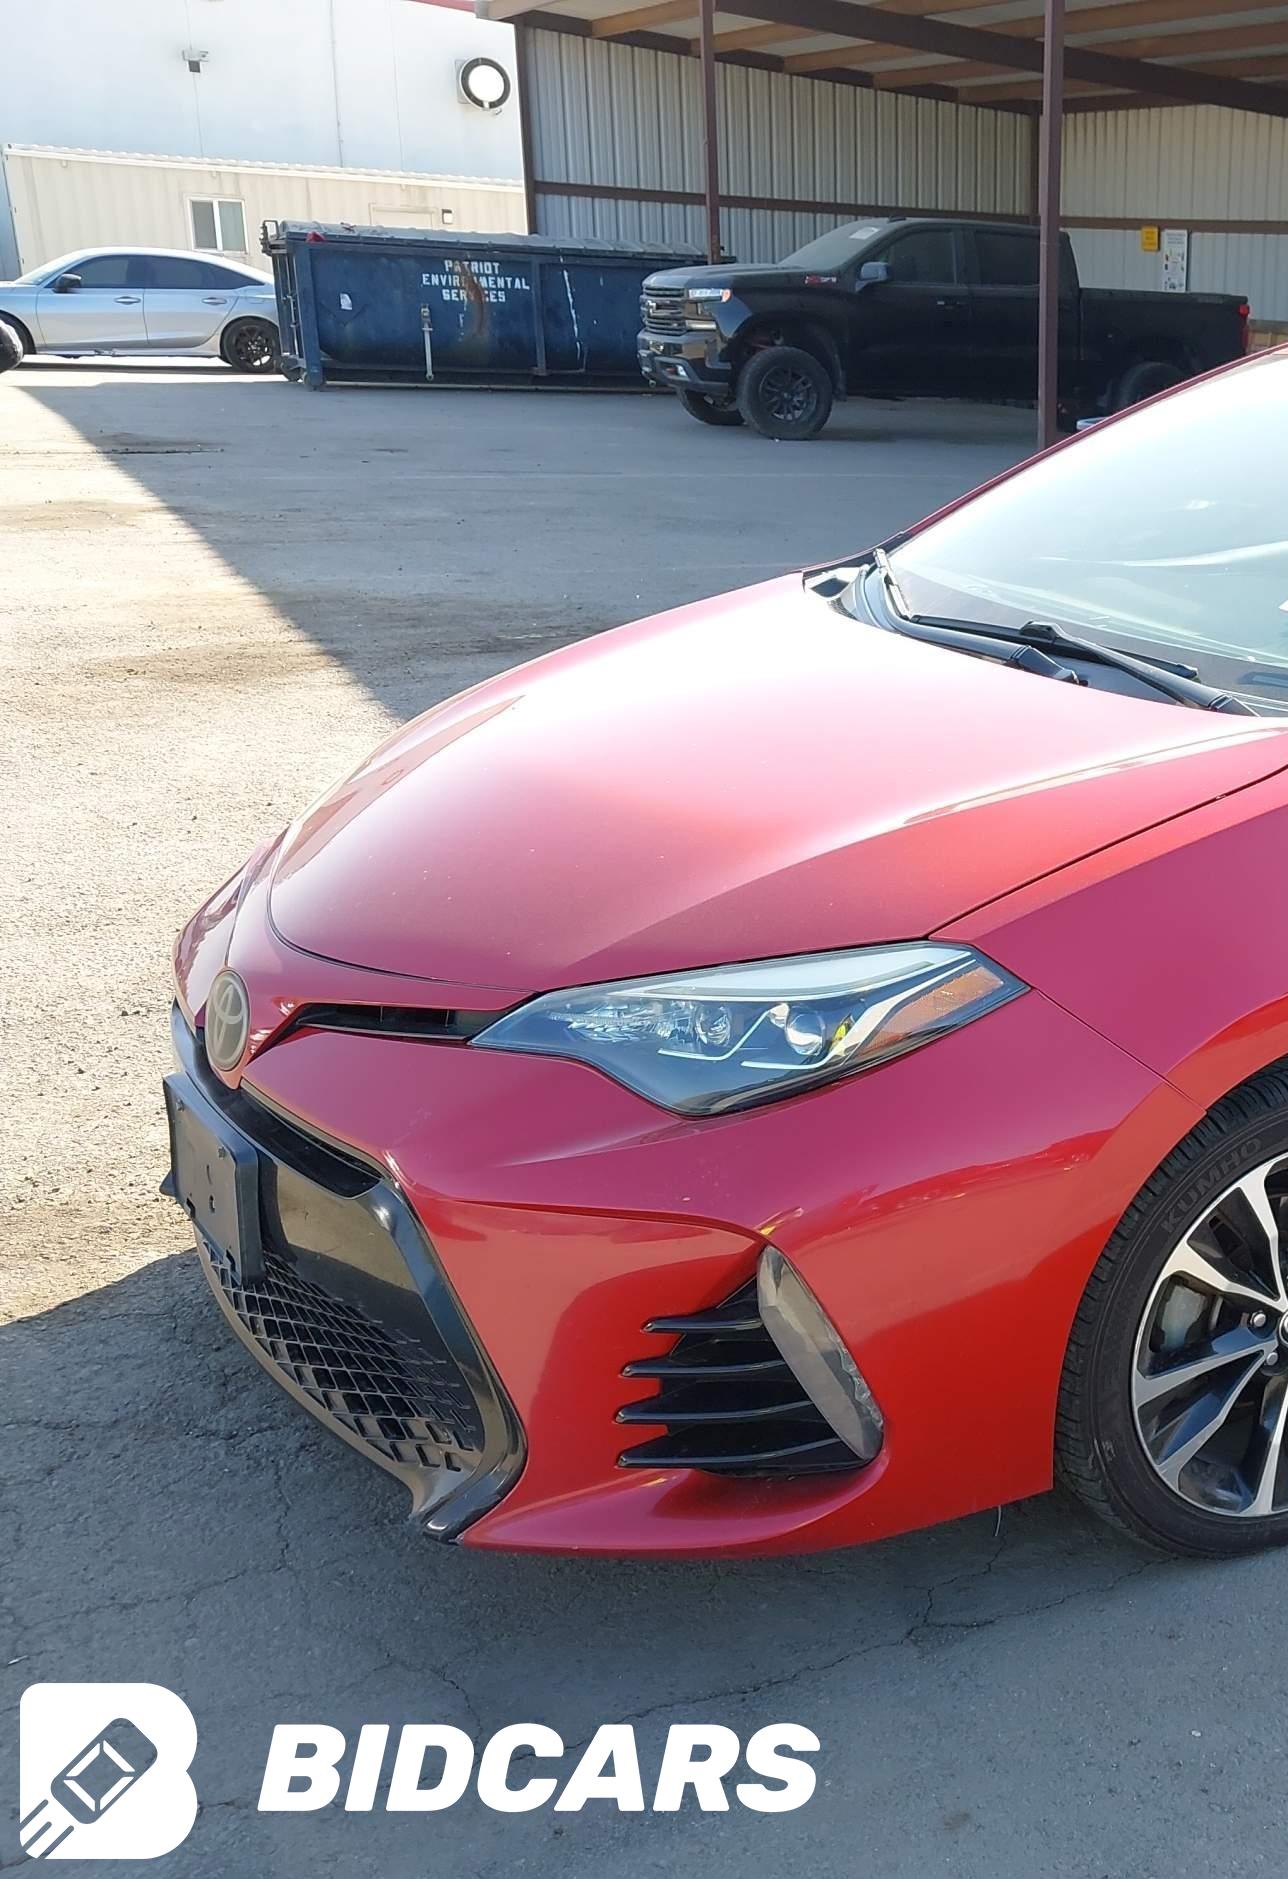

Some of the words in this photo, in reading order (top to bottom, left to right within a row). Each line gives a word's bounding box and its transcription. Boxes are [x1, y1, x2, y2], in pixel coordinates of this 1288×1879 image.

[444, 259, 500, 274] PATRIOT
[422, 273, 530, 290] ENVIRMENTAL
[442, 289, 506, 302] SERCES
[1161, 1138, 1261, 1233] KUMHO
